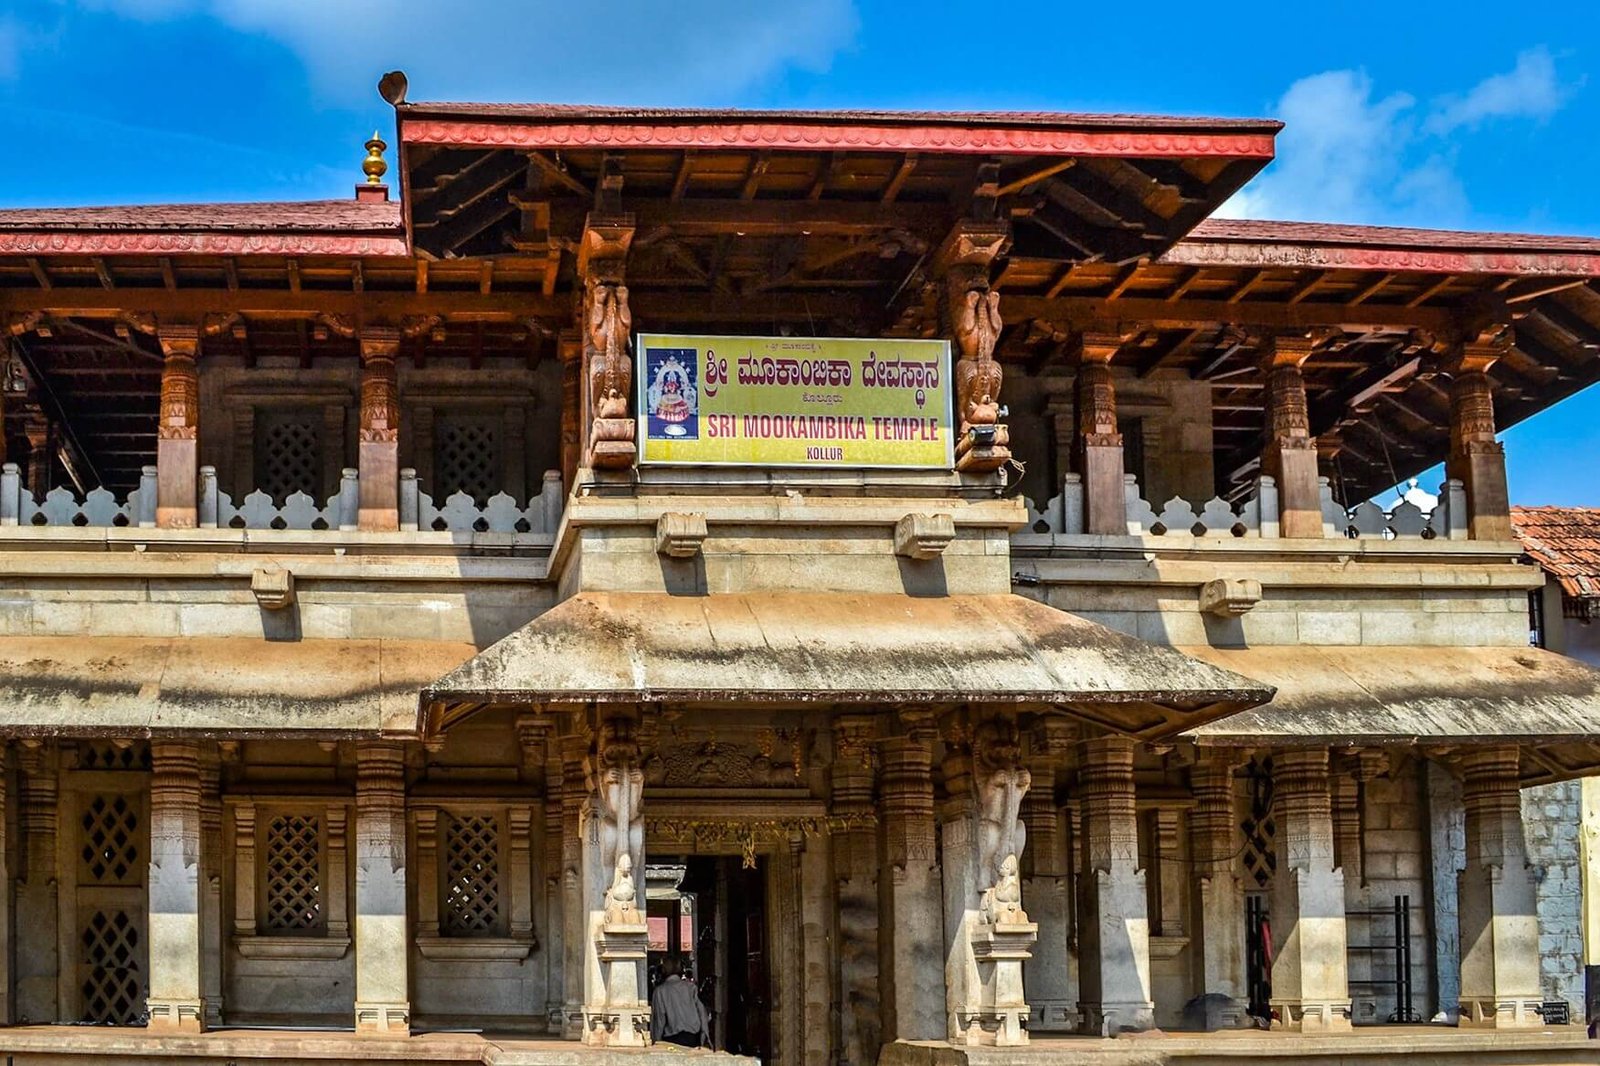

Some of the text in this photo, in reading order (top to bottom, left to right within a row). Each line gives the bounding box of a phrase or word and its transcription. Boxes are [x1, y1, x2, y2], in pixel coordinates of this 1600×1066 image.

[704, 349, 939, 409] ಶ್ರೀ ಮೂಕಾಂಬಿಕಾ ದೇವಸ್ಥಾನ
[708, 414, 939, 440] SRI MOOKAMBIKA TEMPLE
[807, 447, 843, 460] KOLLUR
